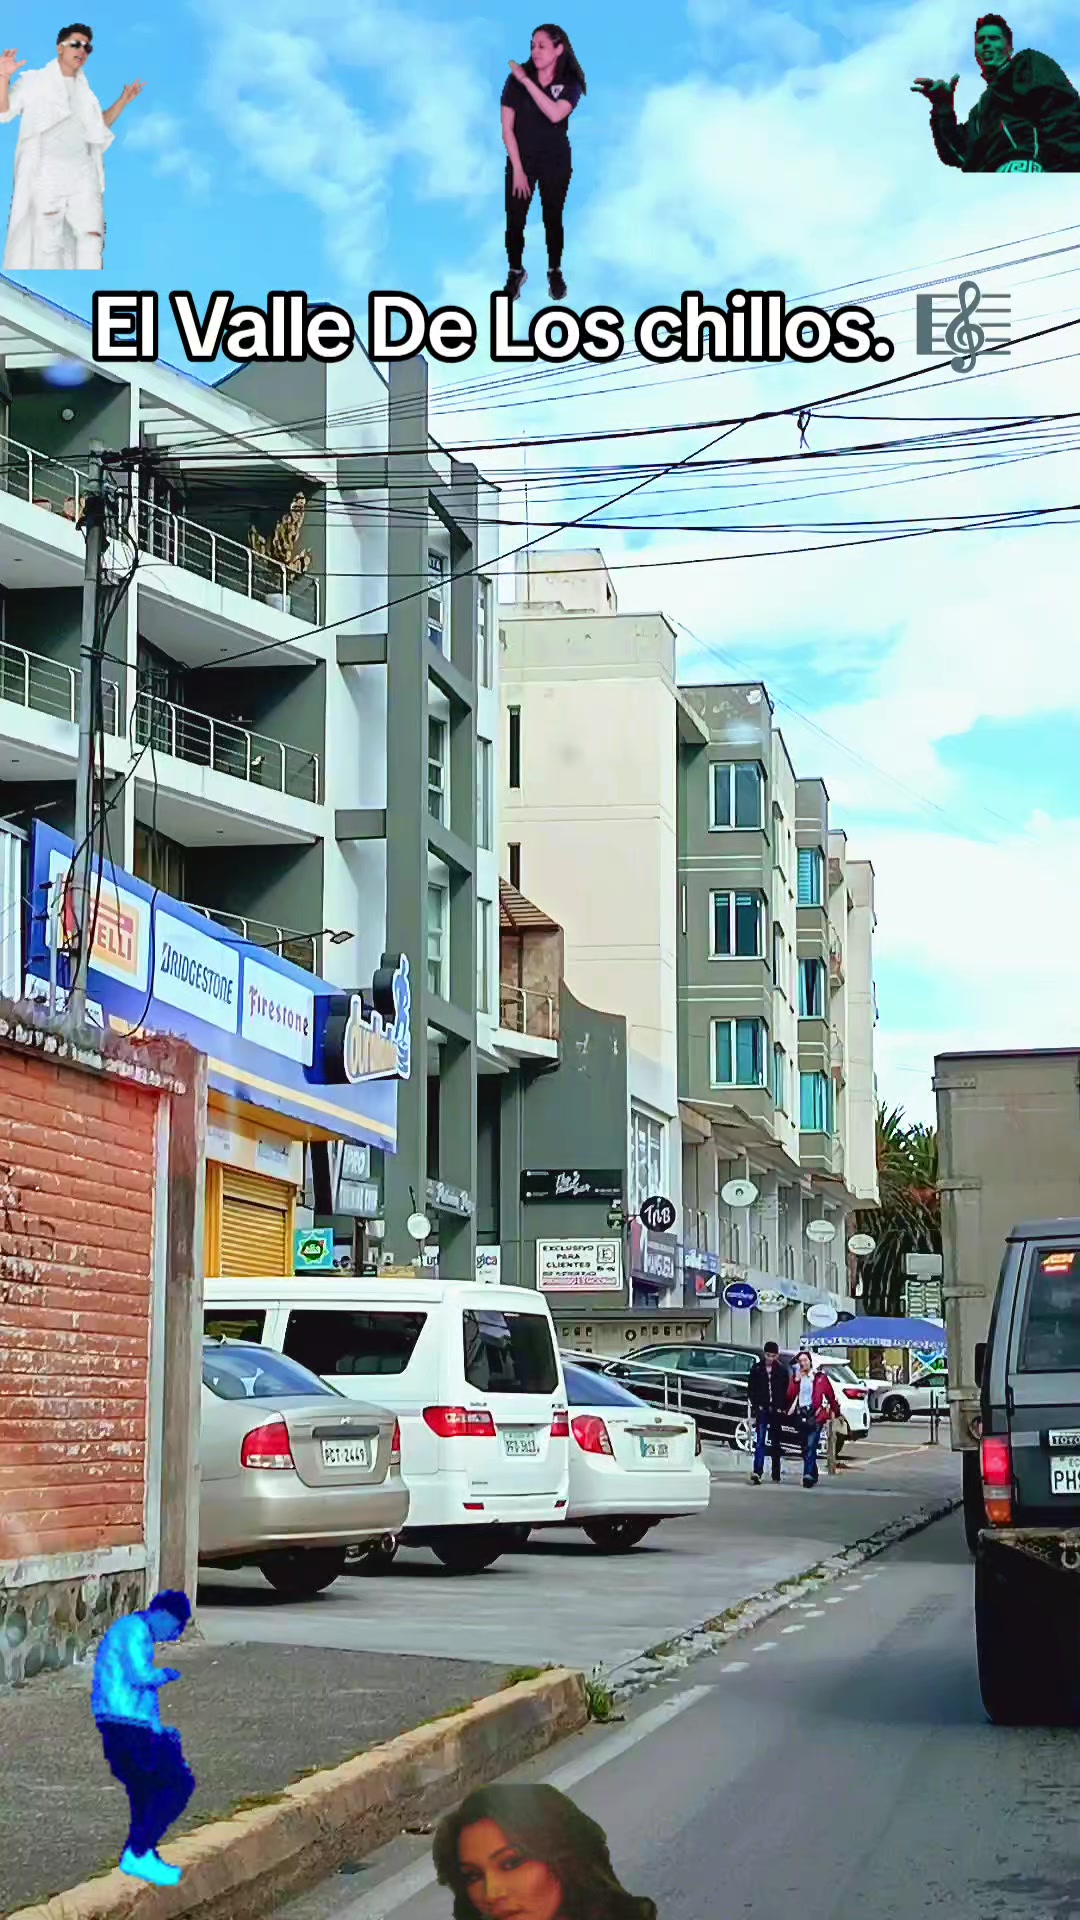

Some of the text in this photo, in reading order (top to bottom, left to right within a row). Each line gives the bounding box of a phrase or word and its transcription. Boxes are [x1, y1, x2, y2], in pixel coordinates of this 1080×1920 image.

[160, 941, 234, 1005] BRIDGESTONE
[249, 985, 309, 1037] Firestone
[543, 1244, 594, 1252] EXCLUSIVO
[1053, 1470, 1080, 1490] PH
